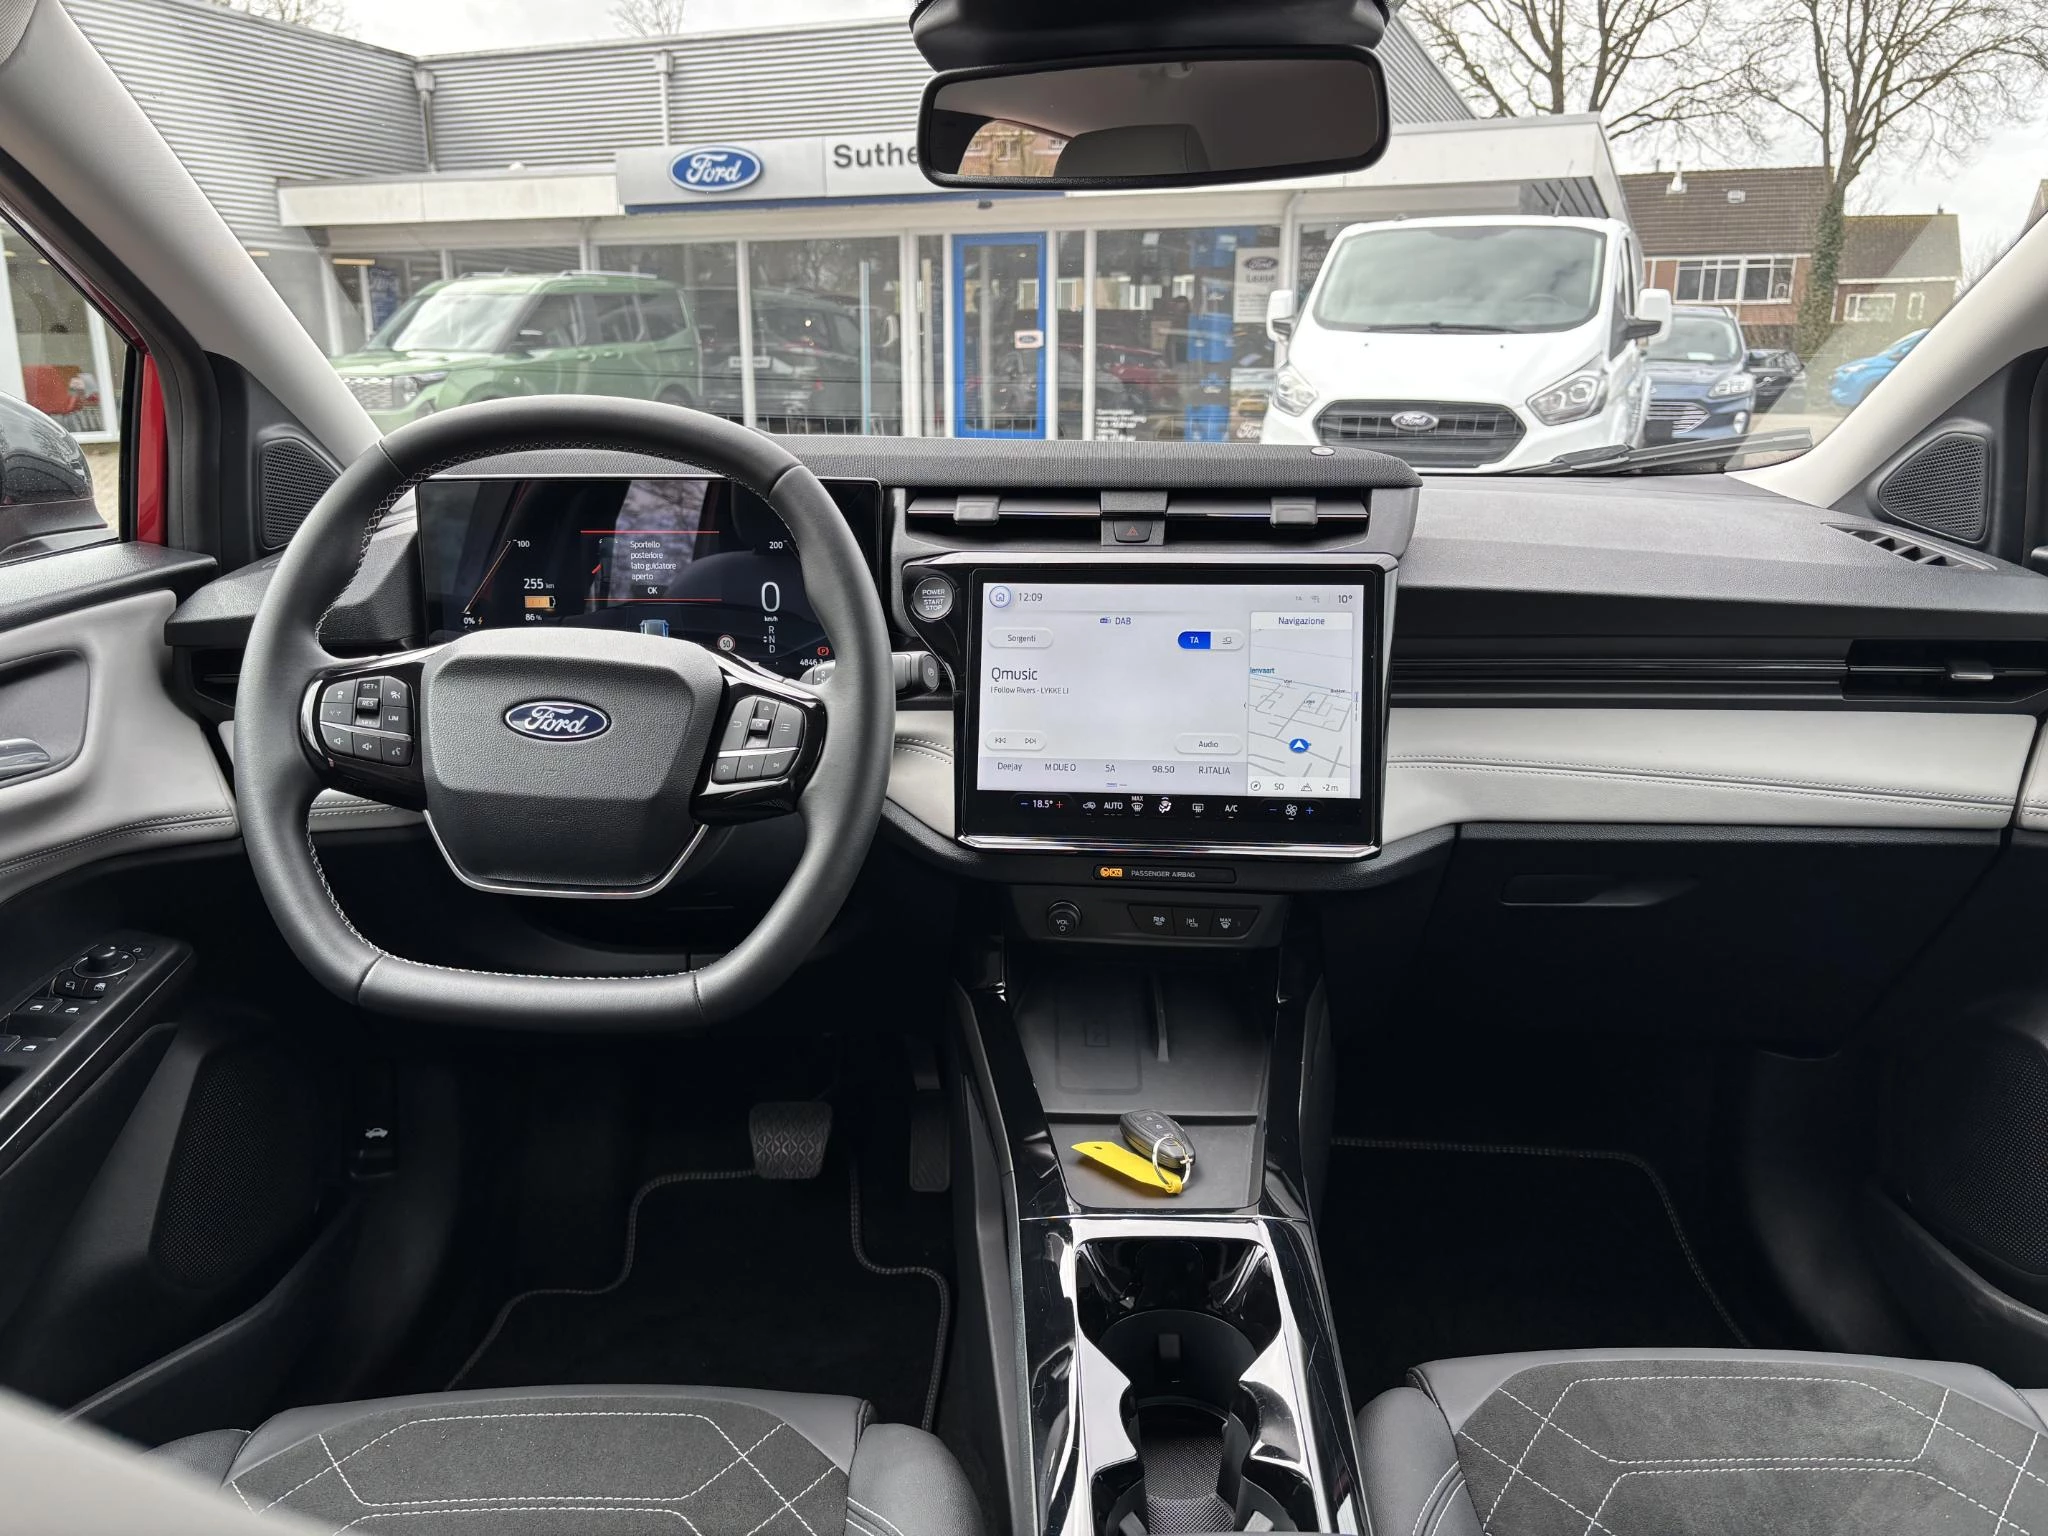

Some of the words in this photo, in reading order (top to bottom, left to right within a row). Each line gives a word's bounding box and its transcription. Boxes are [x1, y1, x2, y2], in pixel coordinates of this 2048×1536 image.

[685, 153, 742, 184] Ford
[630, 541, 660, 549] Sportello
[769, 541, 783, 549] 200
[630, 552, 663, 560] posteriore
[631, 562, 644, 570] lato
[645, 562, 677, 571] guidatore
[631, 573, 654, 581] aperto
[523, 578, 544, 589] 255
[647, 586, 658, 595] OK
[761, 581, 780, 612] 0
[1018, 592, 1043, 602] 12:09
[463, 617, 475, 625] 0%
[525, 613, 535, 621] 86
[1114, 616, 1132, 626] DAB
[1278, 616, 1326, 626] Navigazione
[768, 625, 775, 634] R
[768, 635, 776, 644] N
[1007, 633, 1036, 643] Sorgenti
[1190, 635, 1200, 644] TA
[722, 639, 731, 648] 50
[769, 645, 776, 654] D
[991, 667, 1038, 682] Qmusic
[994, 686, 1016, 694] Follow
[1016, 686, 1036, 694] Rivers
[1040, 687, 1062, 695] LYKKE
[523, 706, 587, 734] Ford
[1198, 739, 1219, 748] Audio
[997, 762, 1023, 772] Deejay
[1152, 765, 1175, 774] 98.50
[1199, 766, 1231, 775] R.ITALIA
[1103, 801, 1124, 810] AUTO
[1224, 804, 1239, 813] A/C
[1131, 870, 1170, 878] PASSENGER
